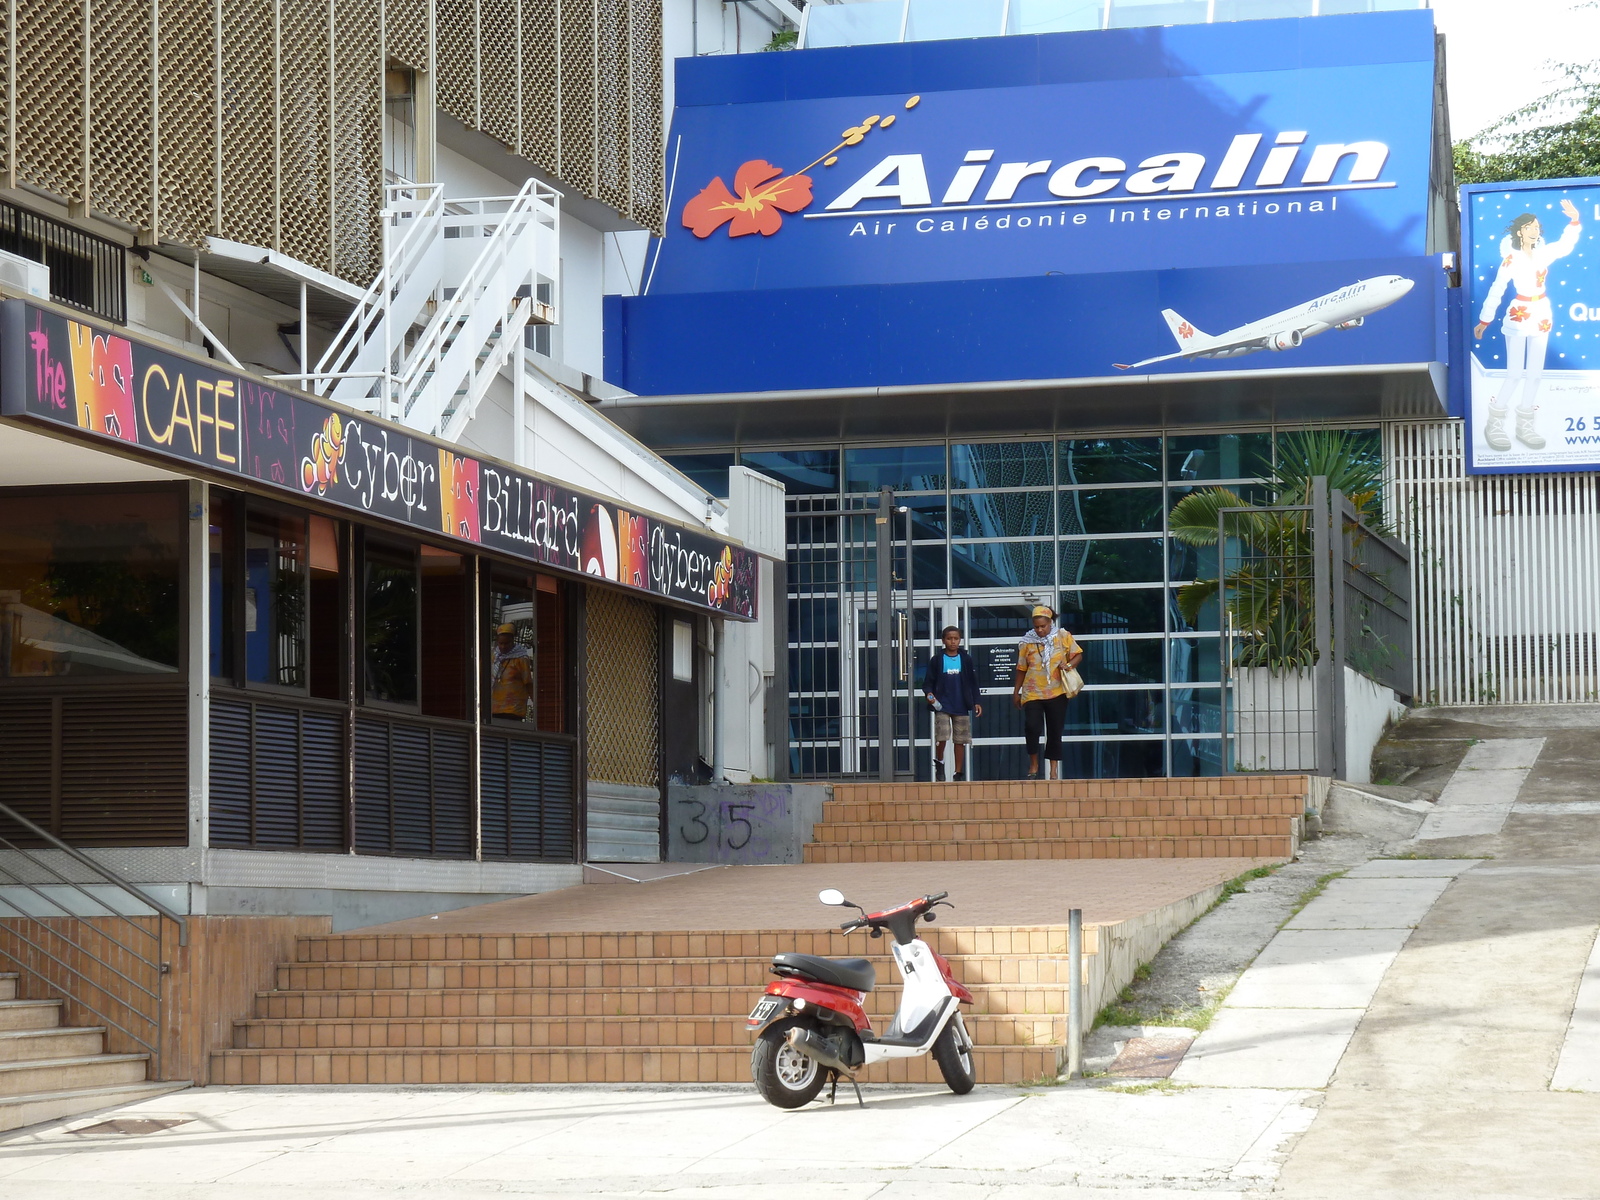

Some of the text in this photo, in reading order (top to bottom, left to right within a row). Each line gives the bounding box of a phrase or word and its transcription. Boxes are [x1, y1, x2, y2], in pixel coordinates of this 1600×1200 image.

[825, 130, 1389, 210] Aircalin
[849, 196, 1338, 237] Air Calédonie International
[1308, 283, 1367, 311] Aircalin
[28, 310, 68, 411] the
[141, 363, 236, 465] CAFÉ
[1564, 416, 1587, 432] 26
[342, 419, 435, 512] Cyber
[483, 468, 581, 558] Billard
[651, 525, 711, 596] Cyber
